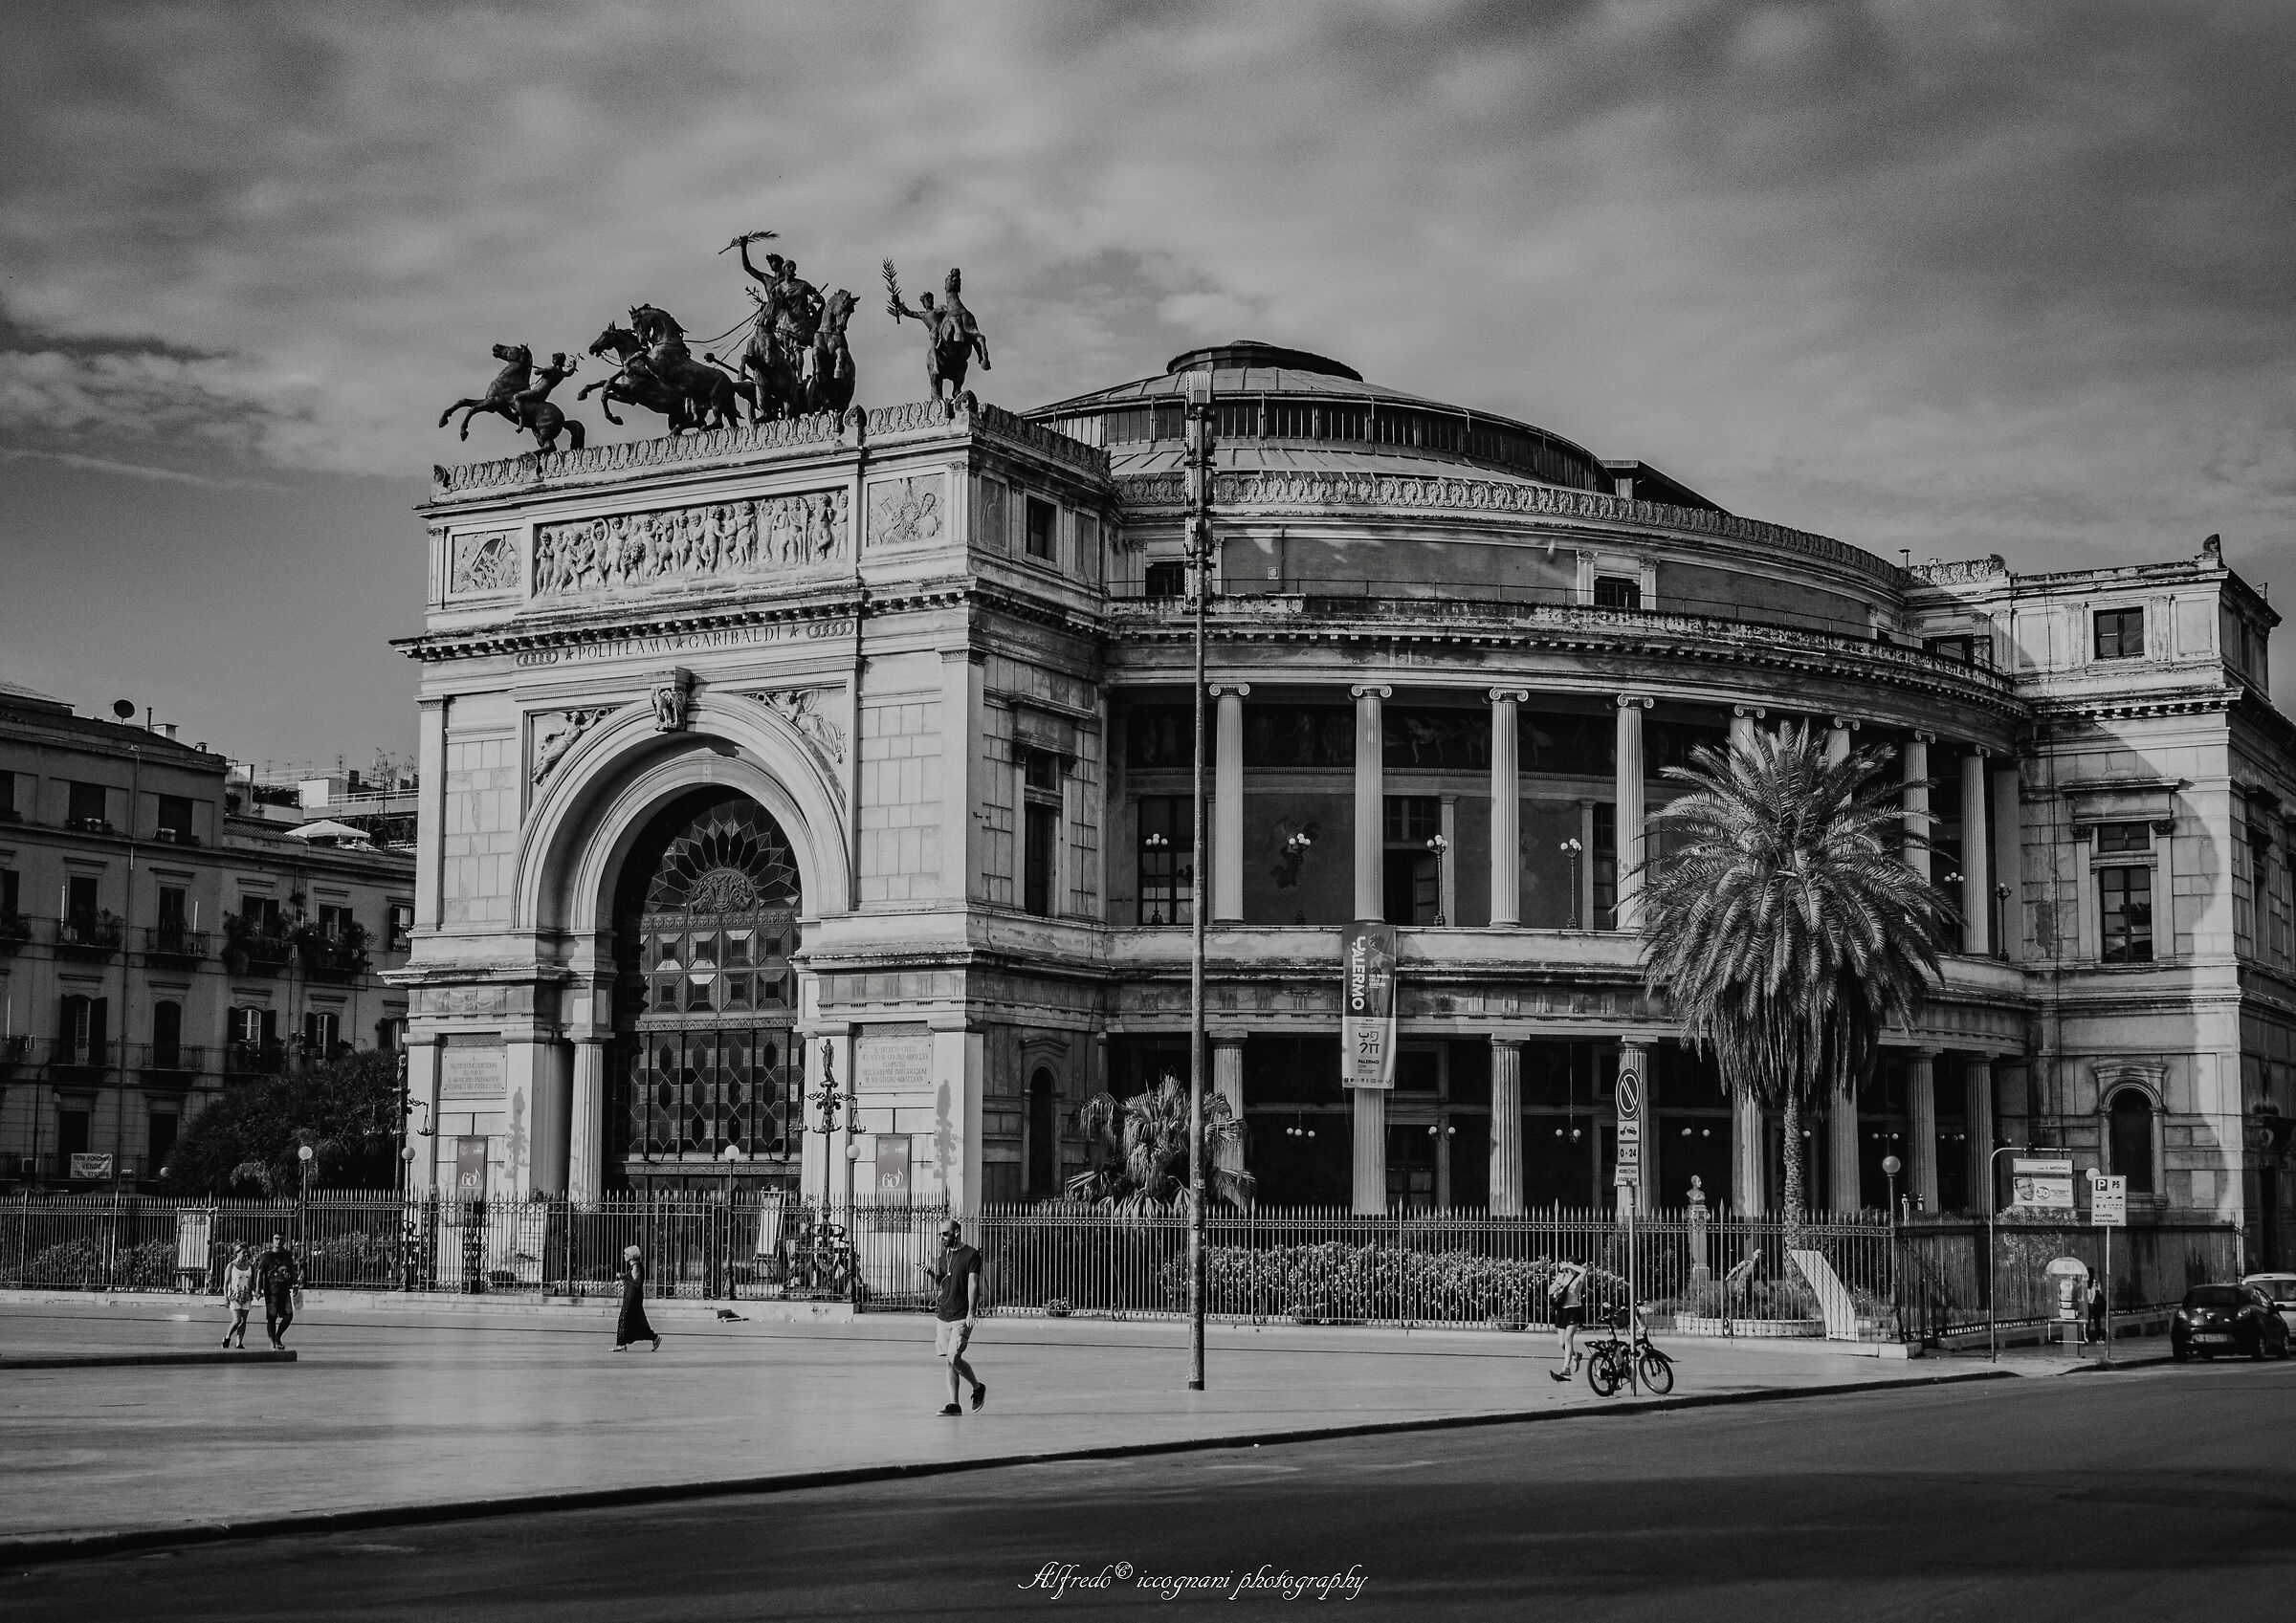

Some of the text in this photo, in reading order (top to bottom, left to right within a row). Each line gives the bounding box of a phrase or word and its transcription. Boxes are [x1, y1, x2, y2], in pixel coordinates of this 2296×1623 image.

[578, 625, 781, 660] POLITEAMA GARIBALDI
[1629, 1148, 1637, 1157] 24
[2098, 1179, 2107, 1190] P
